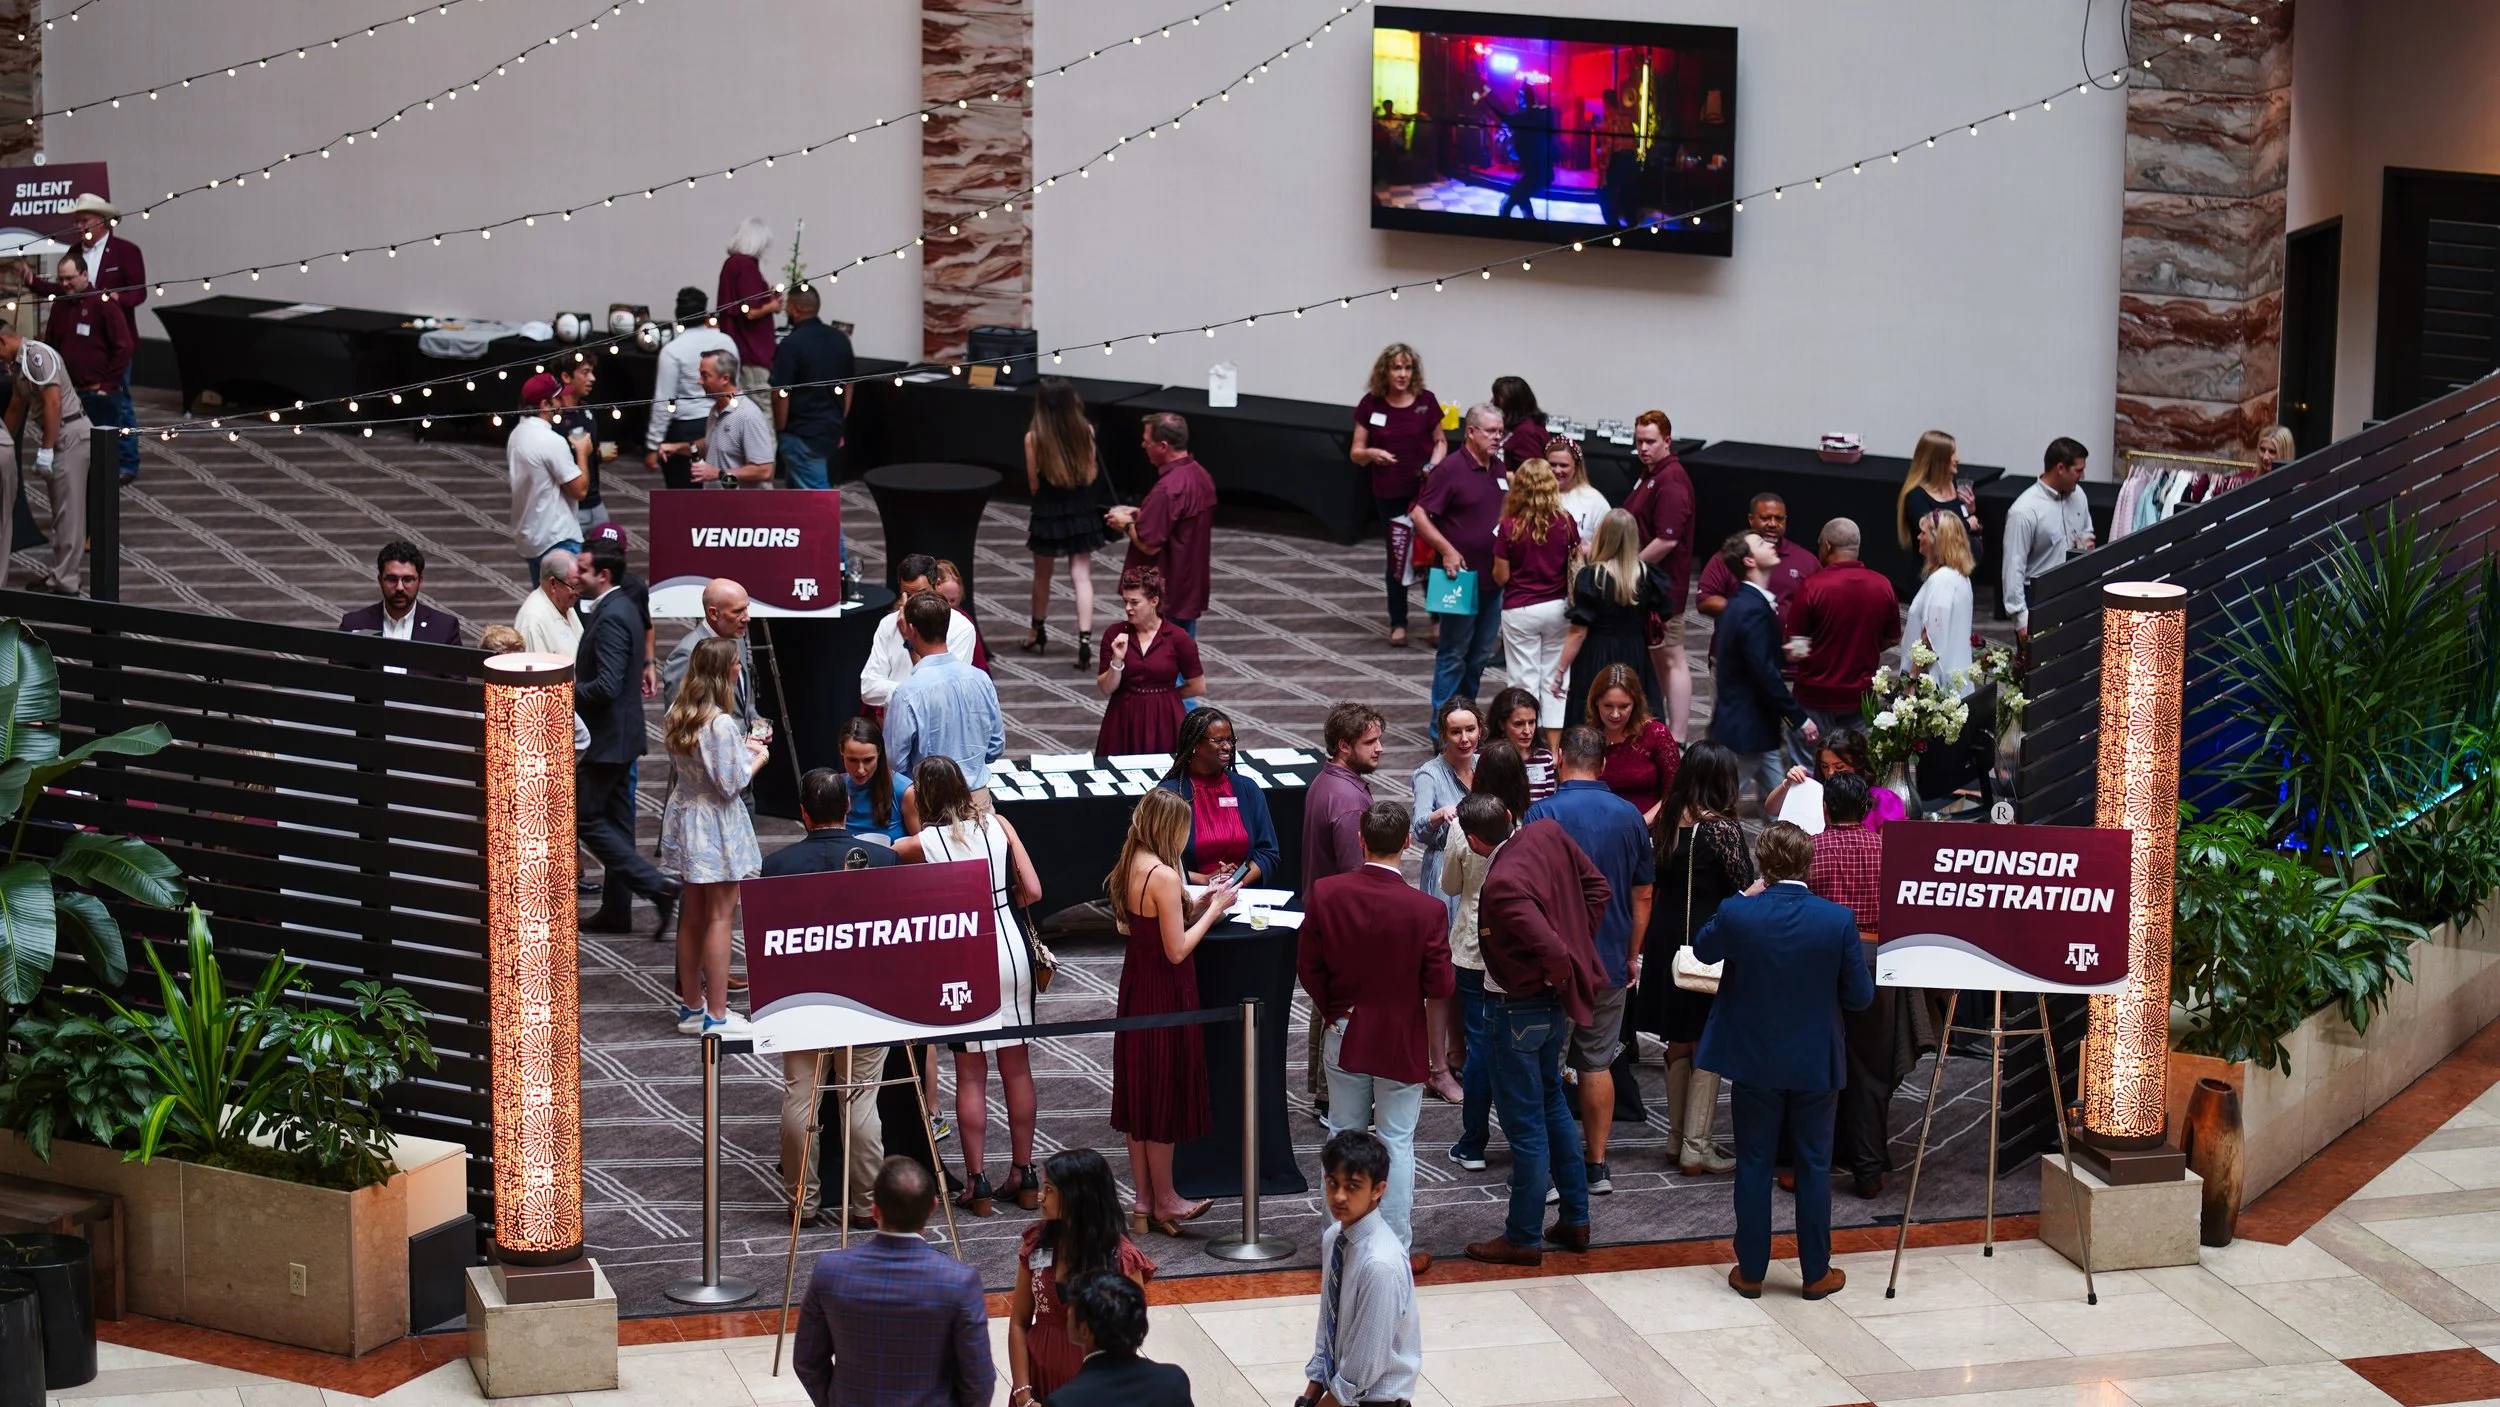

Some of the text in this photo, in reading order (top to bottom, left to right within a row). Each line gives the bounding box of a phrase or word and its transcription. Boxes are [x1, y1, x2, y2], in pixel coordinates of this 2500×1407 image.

[16, 180, 73, 197] SILENT
[691, 528, 800, 548] VENDORS
[1997, 807, 2008, 819] R
[1933, 848, 2079, 877] SPONSOR
[1896, 880, 2114, 913] REGISTRATION
[763, 911, 979, 956] REGISTRATION
